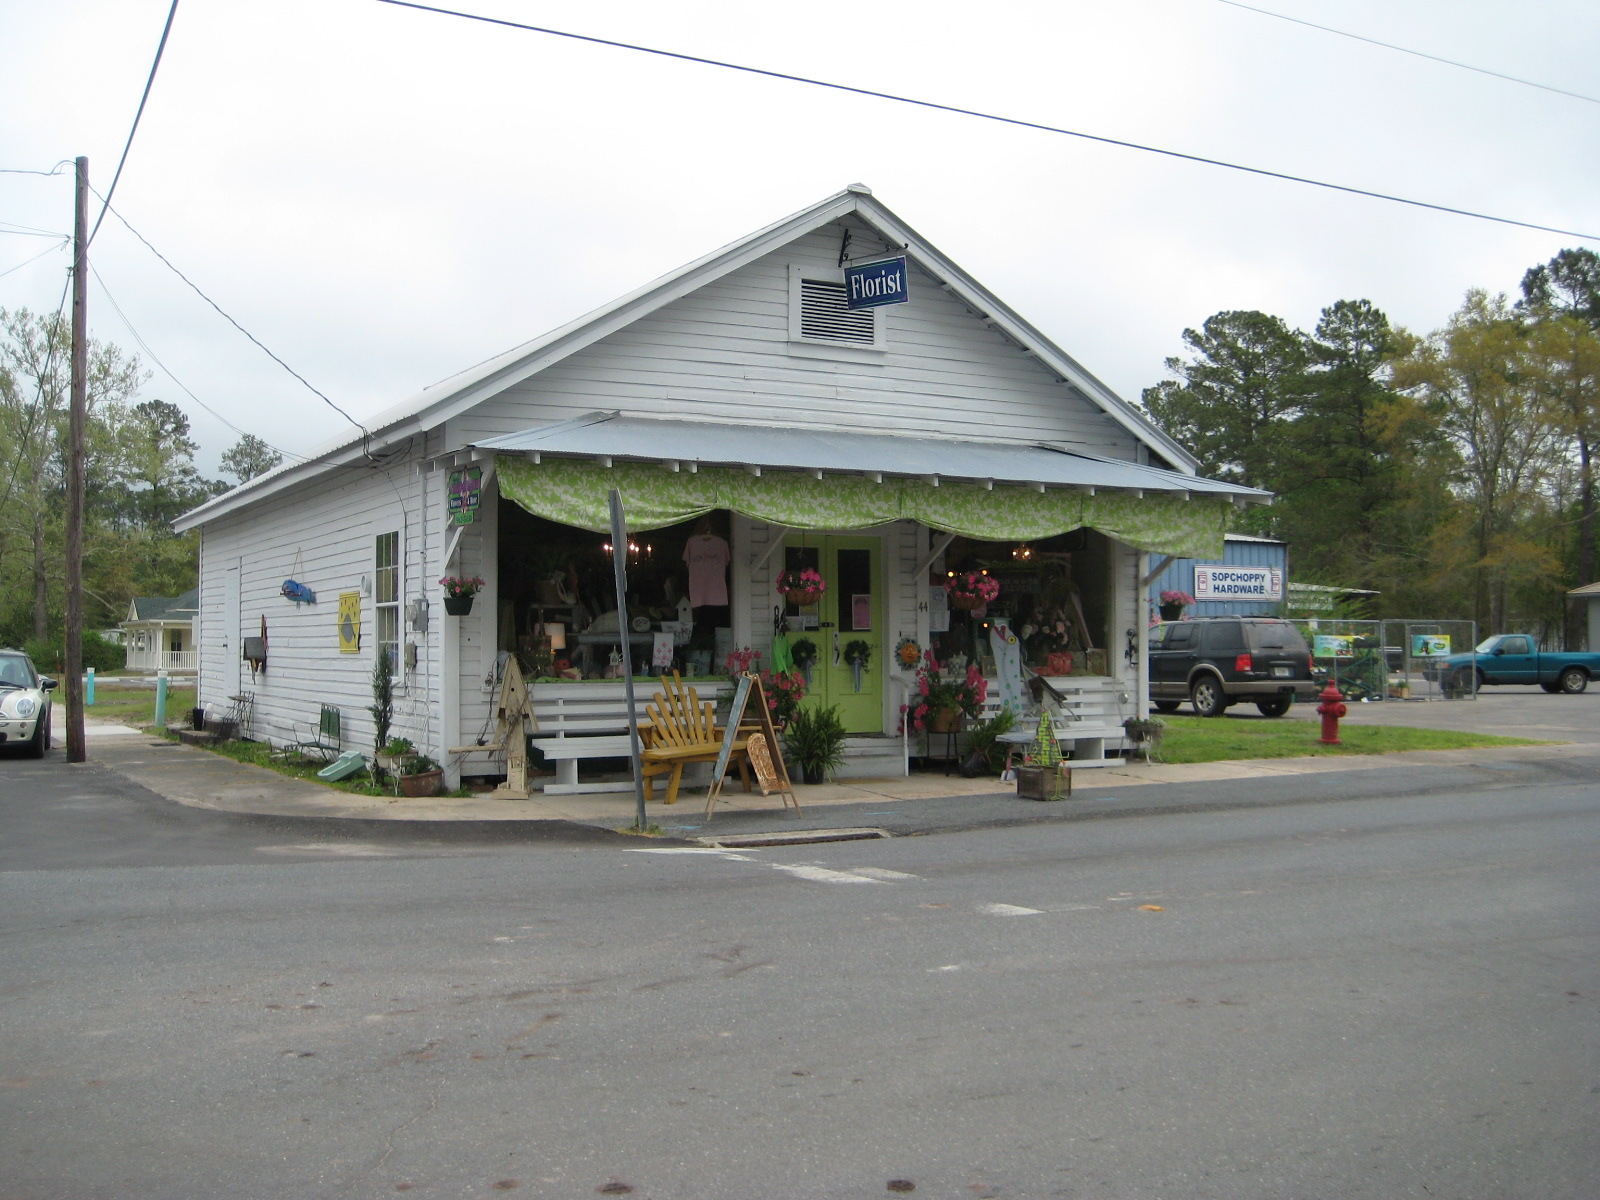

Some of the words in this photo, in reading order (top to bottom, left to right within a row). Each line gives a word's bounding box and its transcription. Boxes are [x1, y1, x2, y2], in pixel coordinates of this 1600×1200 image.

[851, 269, 902, 299] Florist
[1211, 572, 1266, 582] SOPCHOPPY
[1213, 584, 1265, 594] HARDWARE
[919, 601, 928, 612] 44
